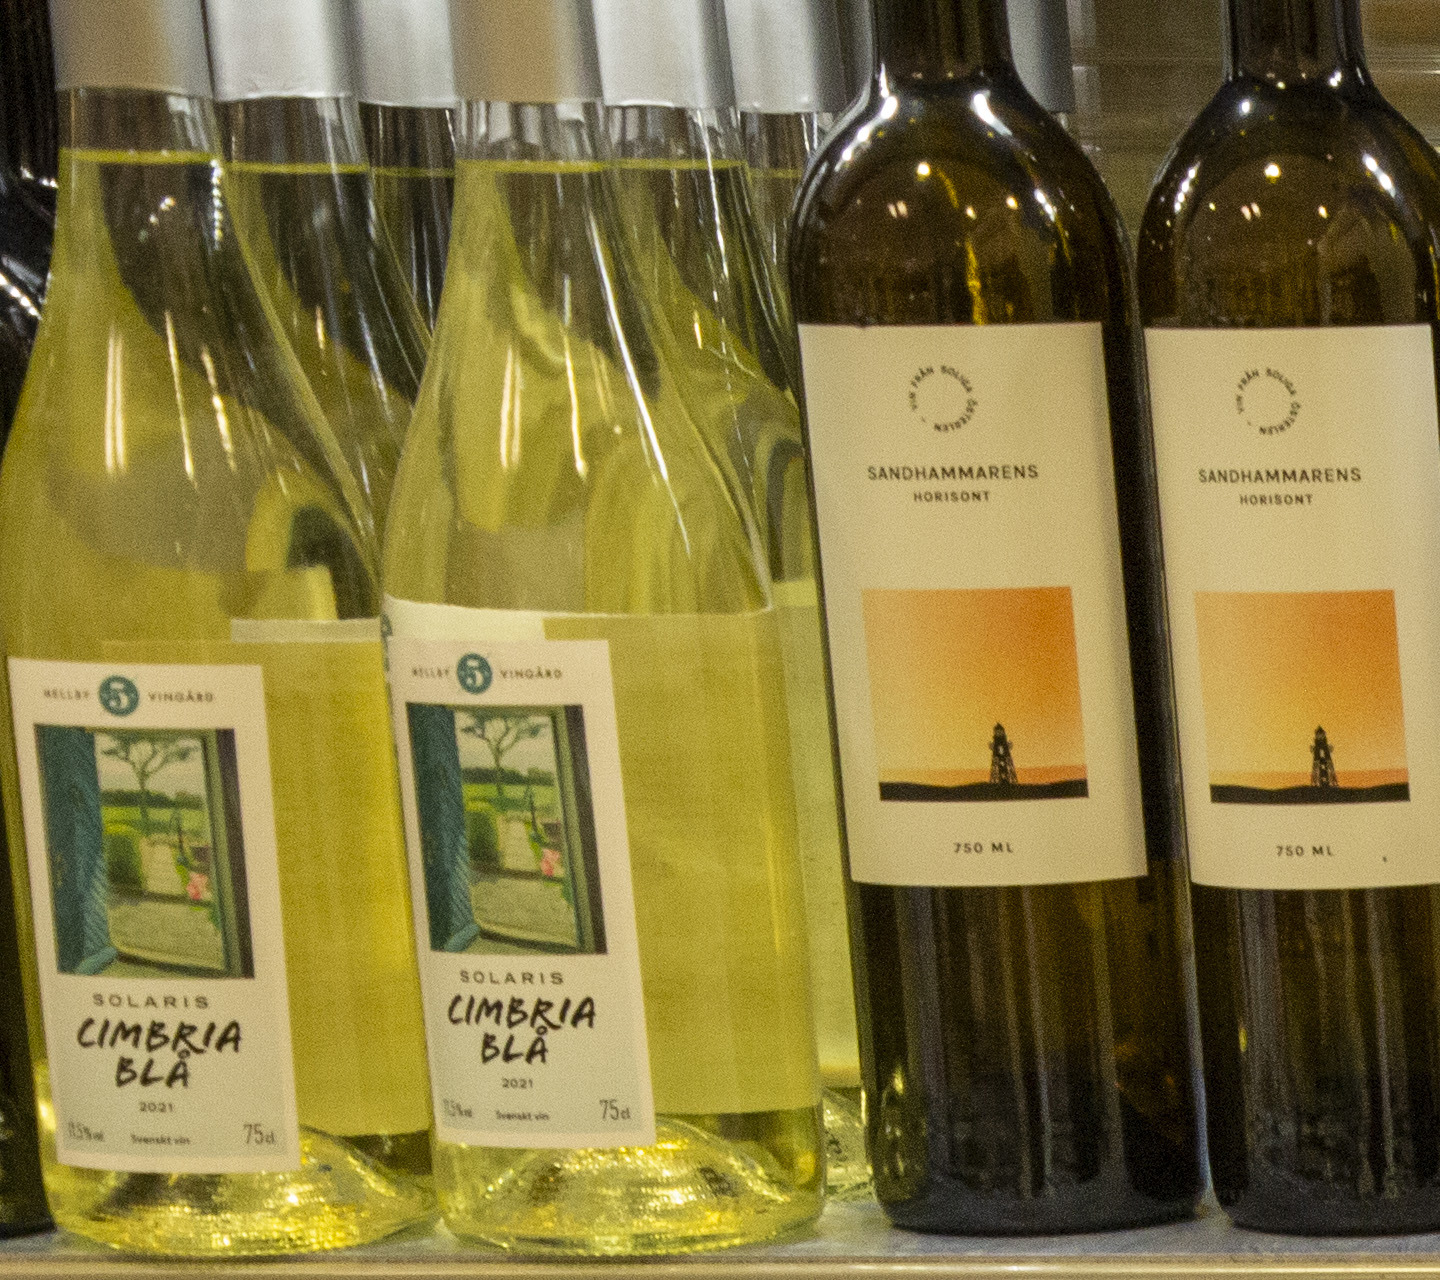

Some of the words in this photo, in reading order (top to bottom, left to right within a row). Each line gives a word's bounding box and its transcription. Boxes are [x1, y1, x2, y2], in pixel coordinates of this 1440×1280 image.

[867, 464, 1039, 481] SANDHAMMARENS
[1199, 468, 1361, 484] SANDHAMMARENS
[914, 491, 990, 501] HORISONT
[1240, 494, 1313, 505] HORISONT
[954, 842, 982, 853] 750
[992, 842, 1013, 852] ML
[460, 970, 564, 986] SOLARIS
[92, 993, 210, 1009] SOLARIS
[447, 994, 596, 1031] CIMBRIA
[77, 1017, 242, 1055] CIMBRIA
[480, 1026, 548, 1065] BLÅ
[115, 1050, 191, 1088] BLÅ
